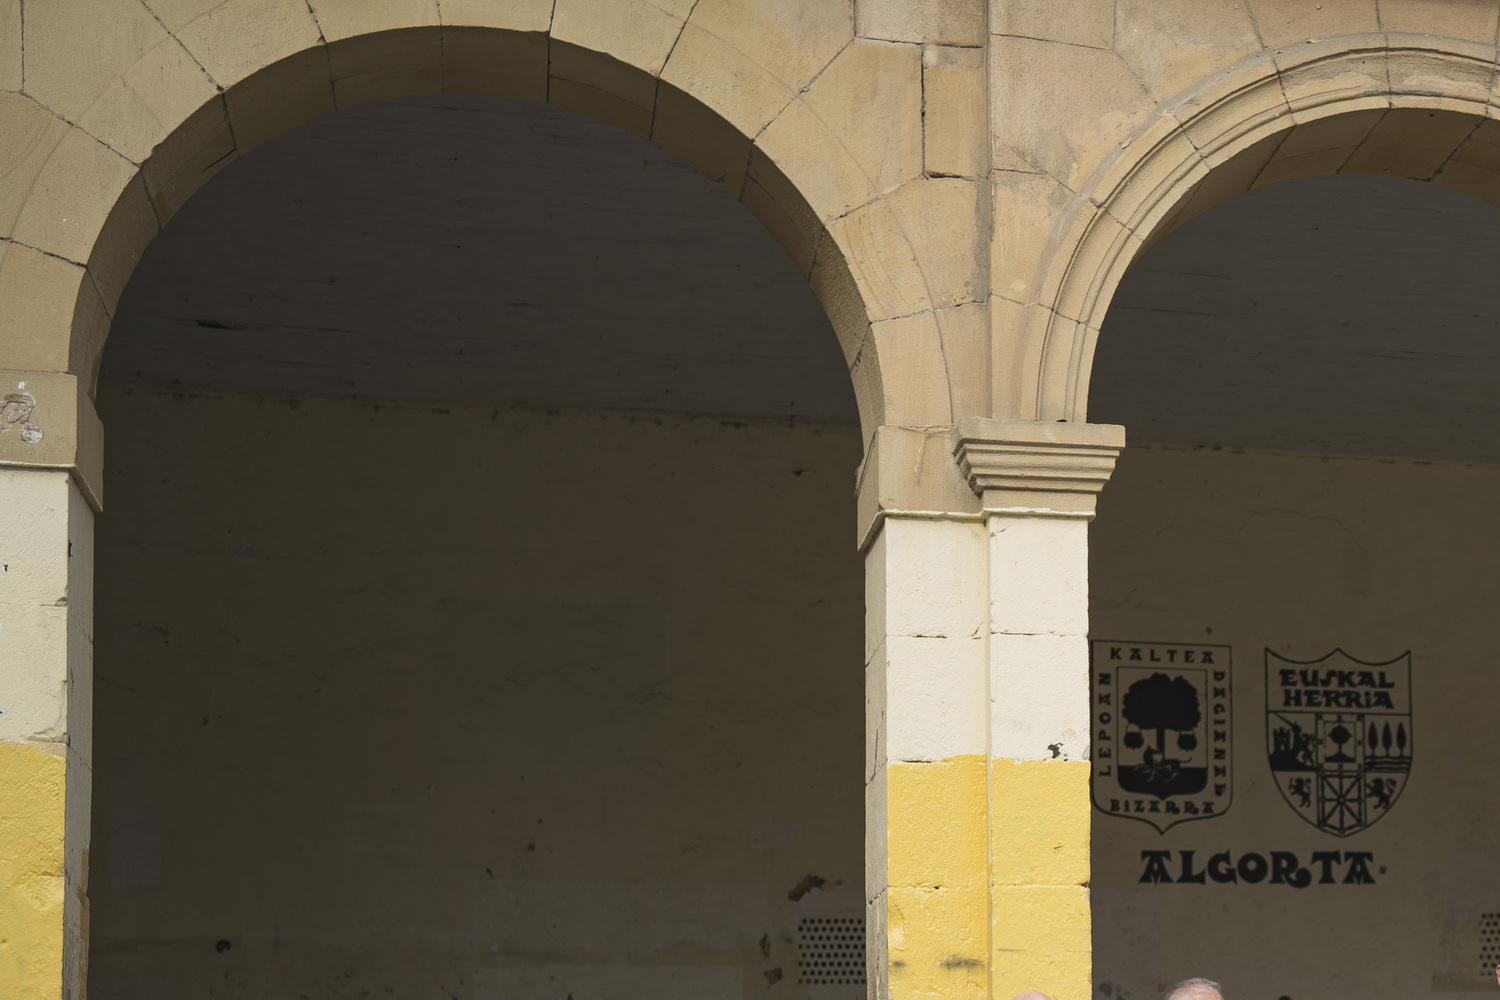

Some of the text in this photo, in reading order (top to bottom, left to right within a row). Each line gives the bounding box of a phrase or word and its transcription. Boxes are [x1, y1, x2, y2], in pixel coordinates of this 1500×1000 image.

[1110, 647, 1215, 664] KALTEA
[1278, 668, 1396, 689] EUSKAL
[1099, 673, 1112, 777] LEPOAN
[1138, 850, 1377, 888] ALGORTA
